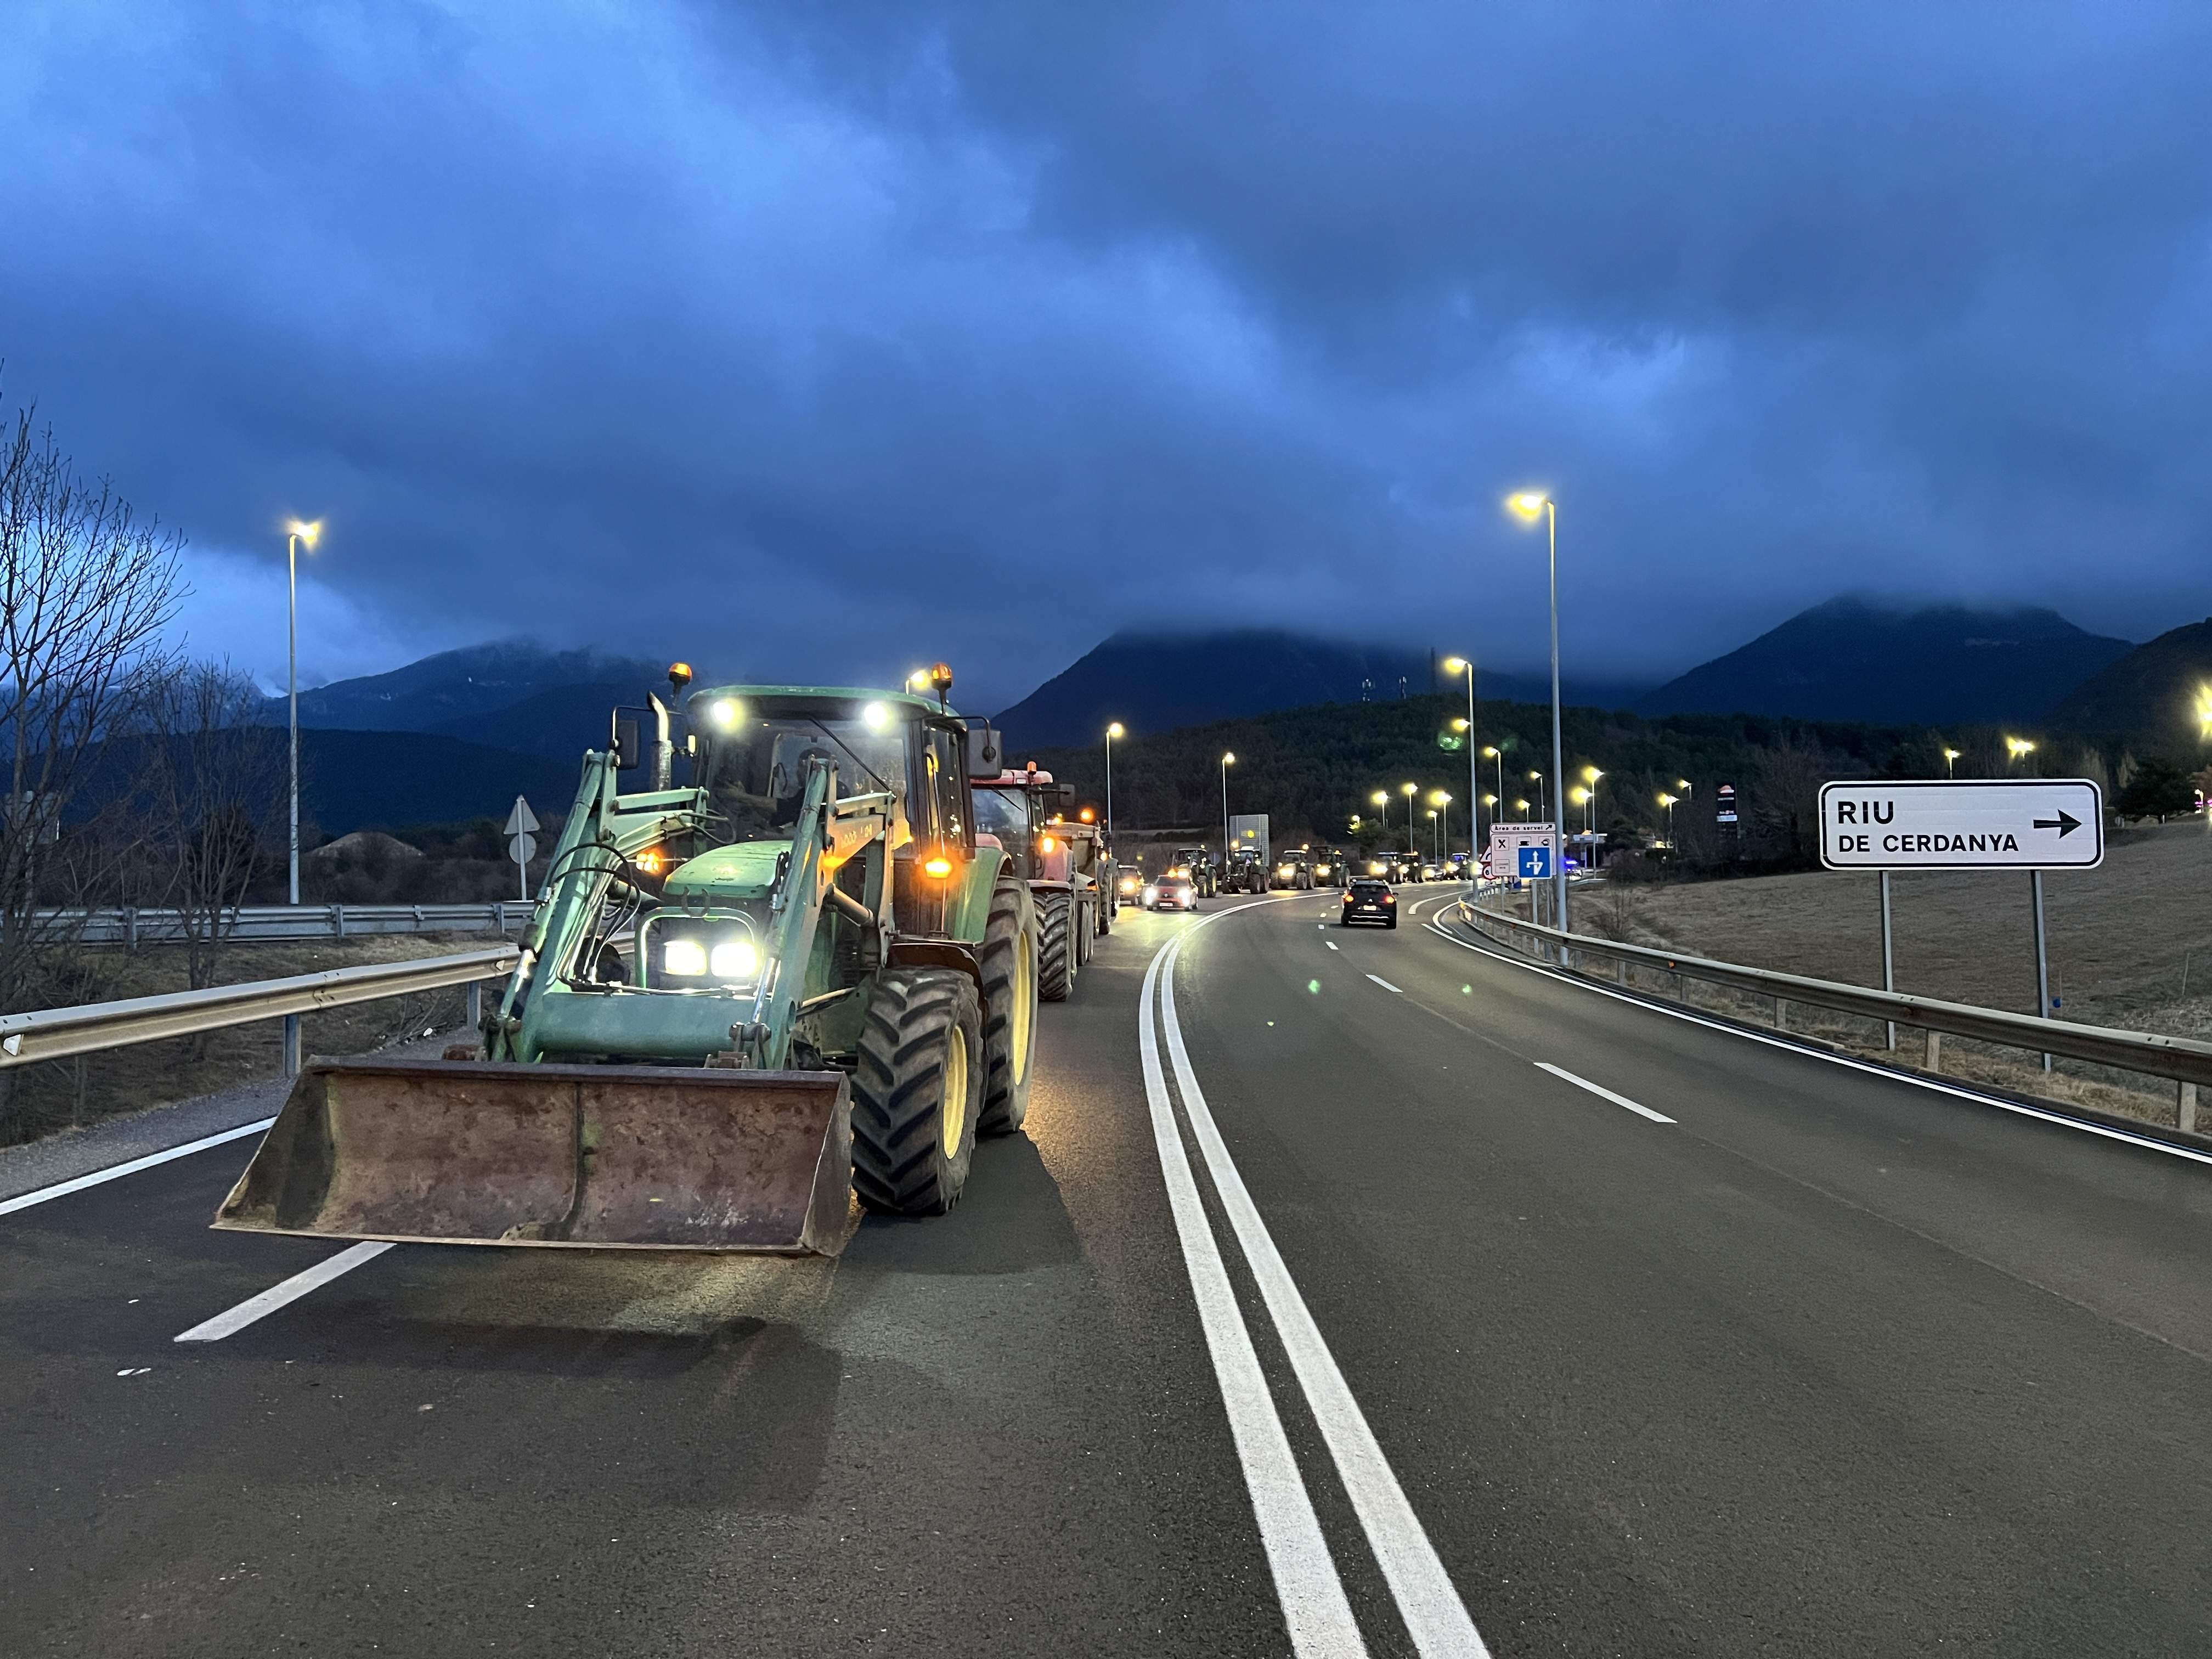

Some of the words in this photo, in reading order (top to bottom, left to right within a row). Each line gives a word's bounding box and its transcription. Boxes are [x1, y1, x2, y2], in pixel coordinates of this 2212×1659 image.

[1838, 801, 1894, 825] RIU
[1838, 834, 1870, 853] DE
[1882, 834, 2019, 852] CERDANYA
